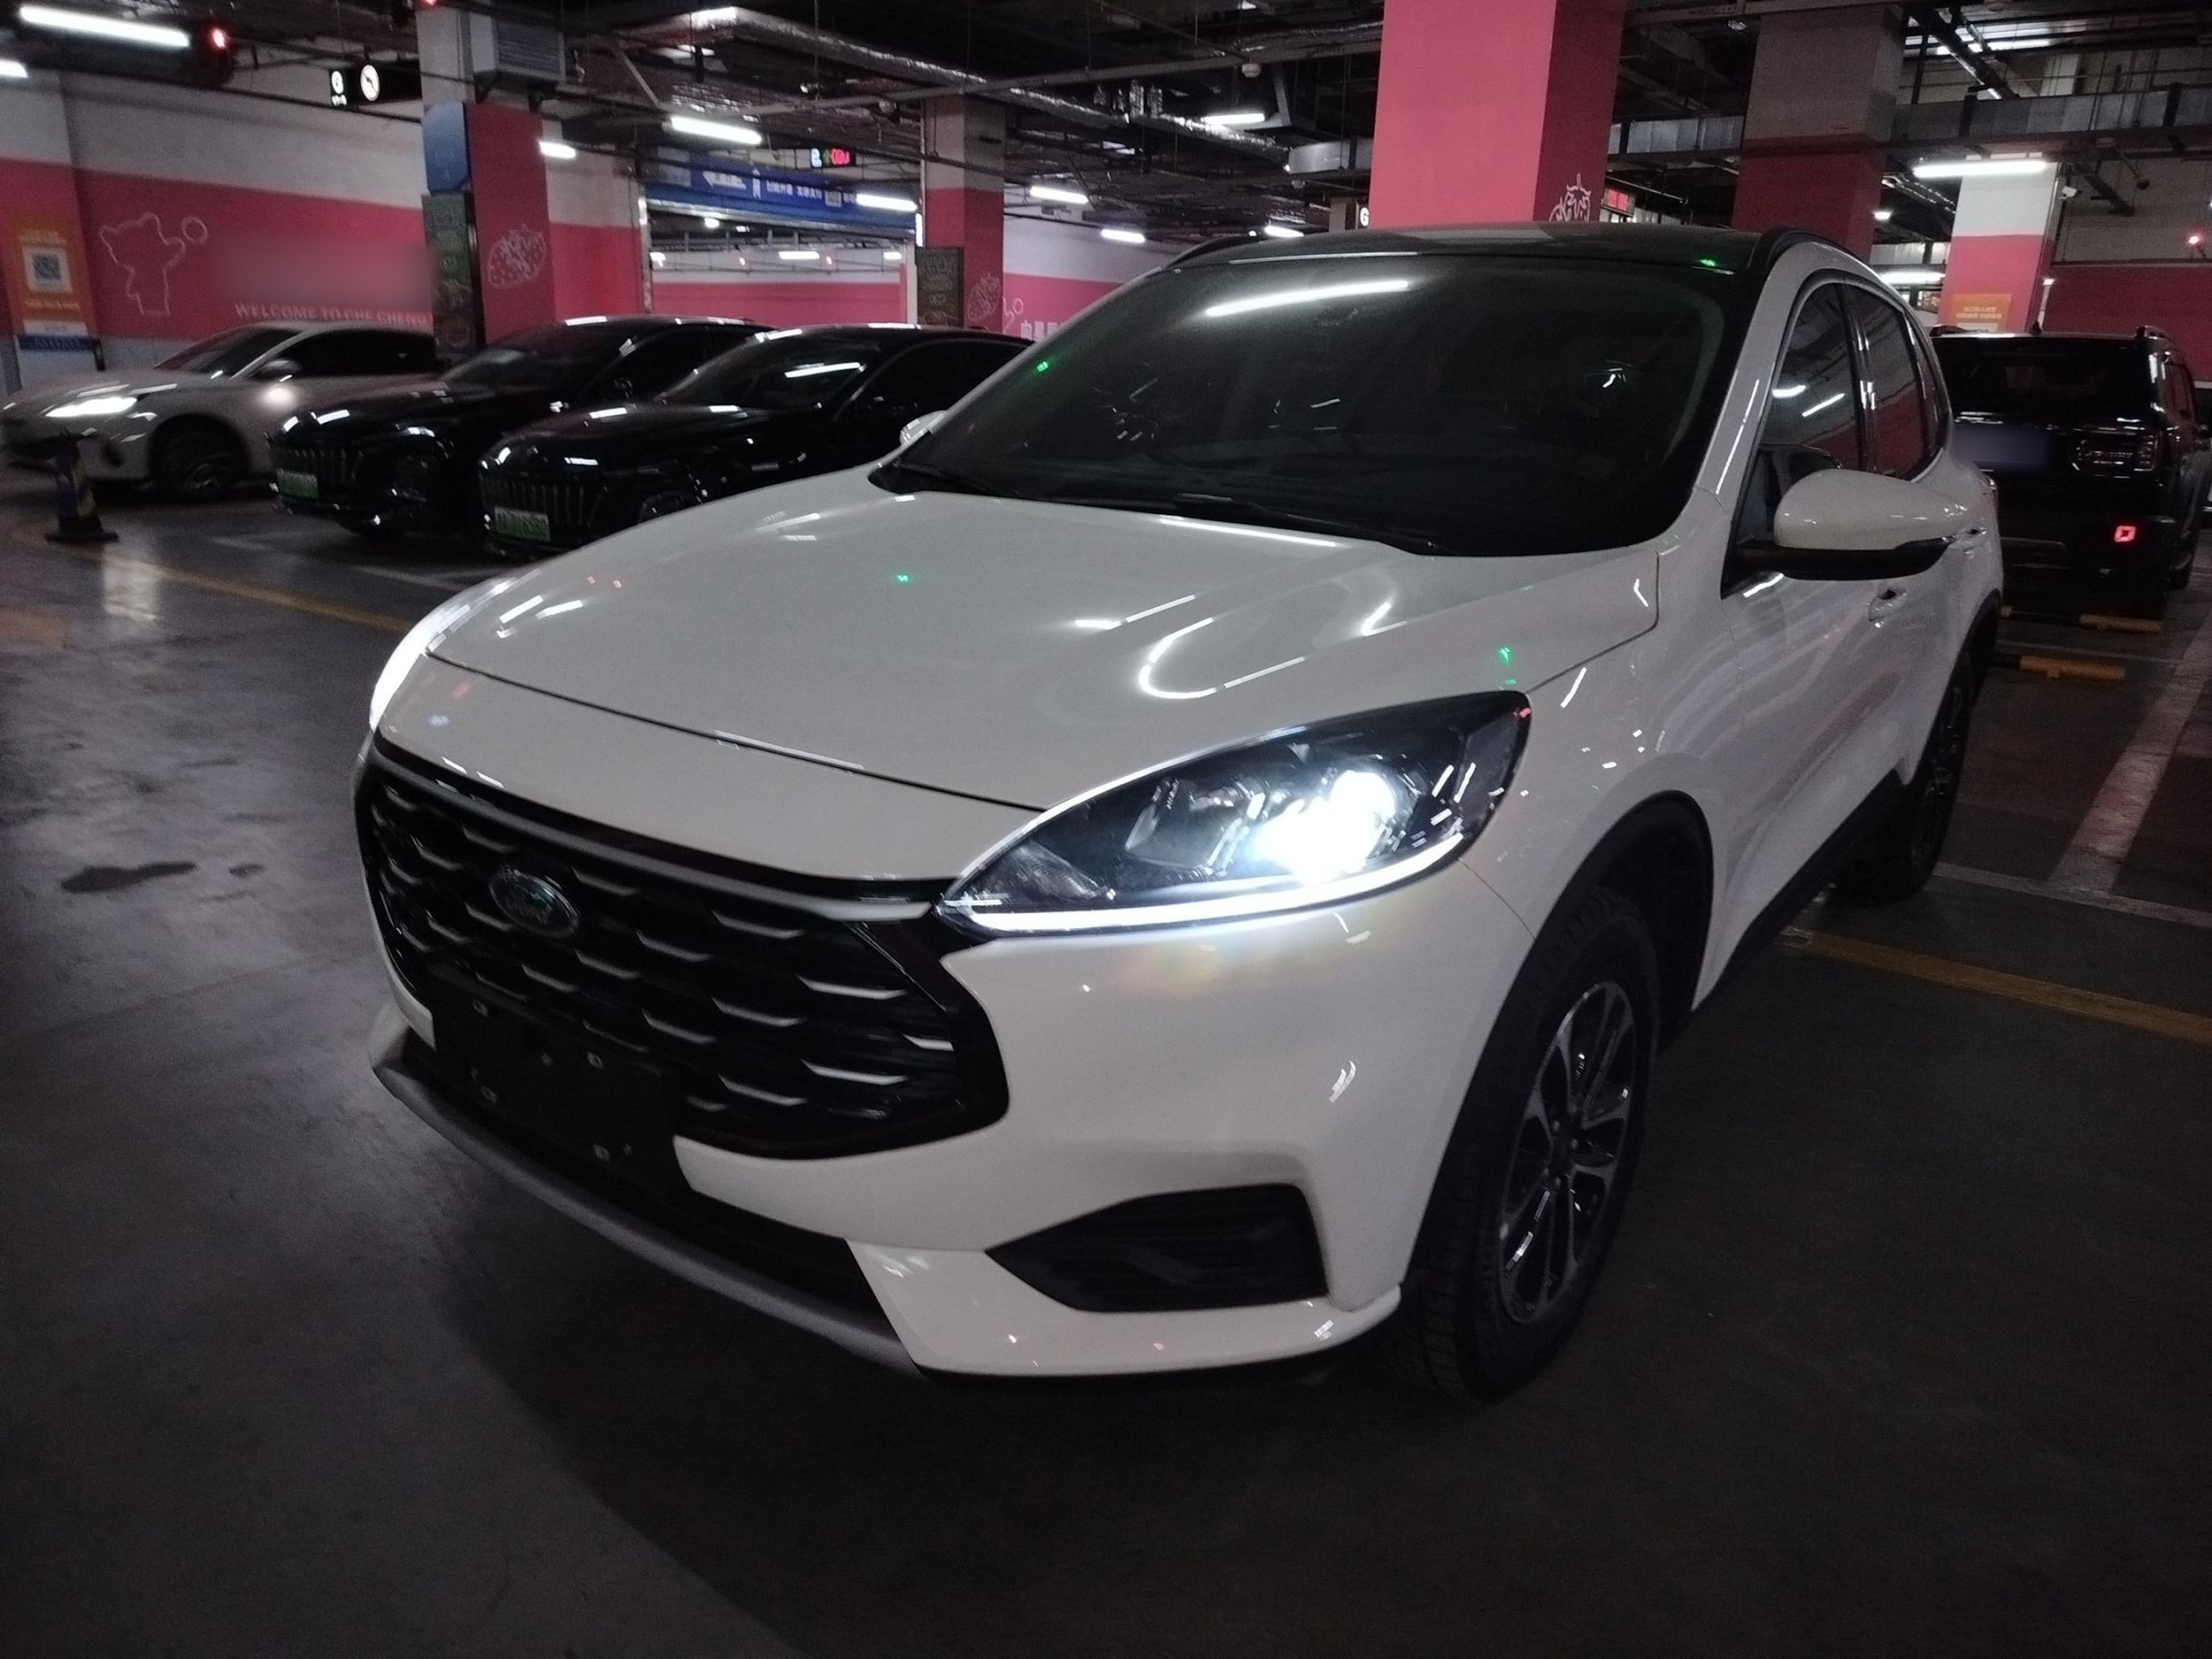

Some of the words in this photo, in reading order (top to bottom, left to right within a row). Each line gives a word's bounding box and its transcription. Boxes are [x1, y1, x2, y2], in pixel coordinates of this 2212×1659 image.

[1360, 207, 1370, 227] G
[234, 302, 317, 319] WELCOME
[319, 306, 342, 319] TO
